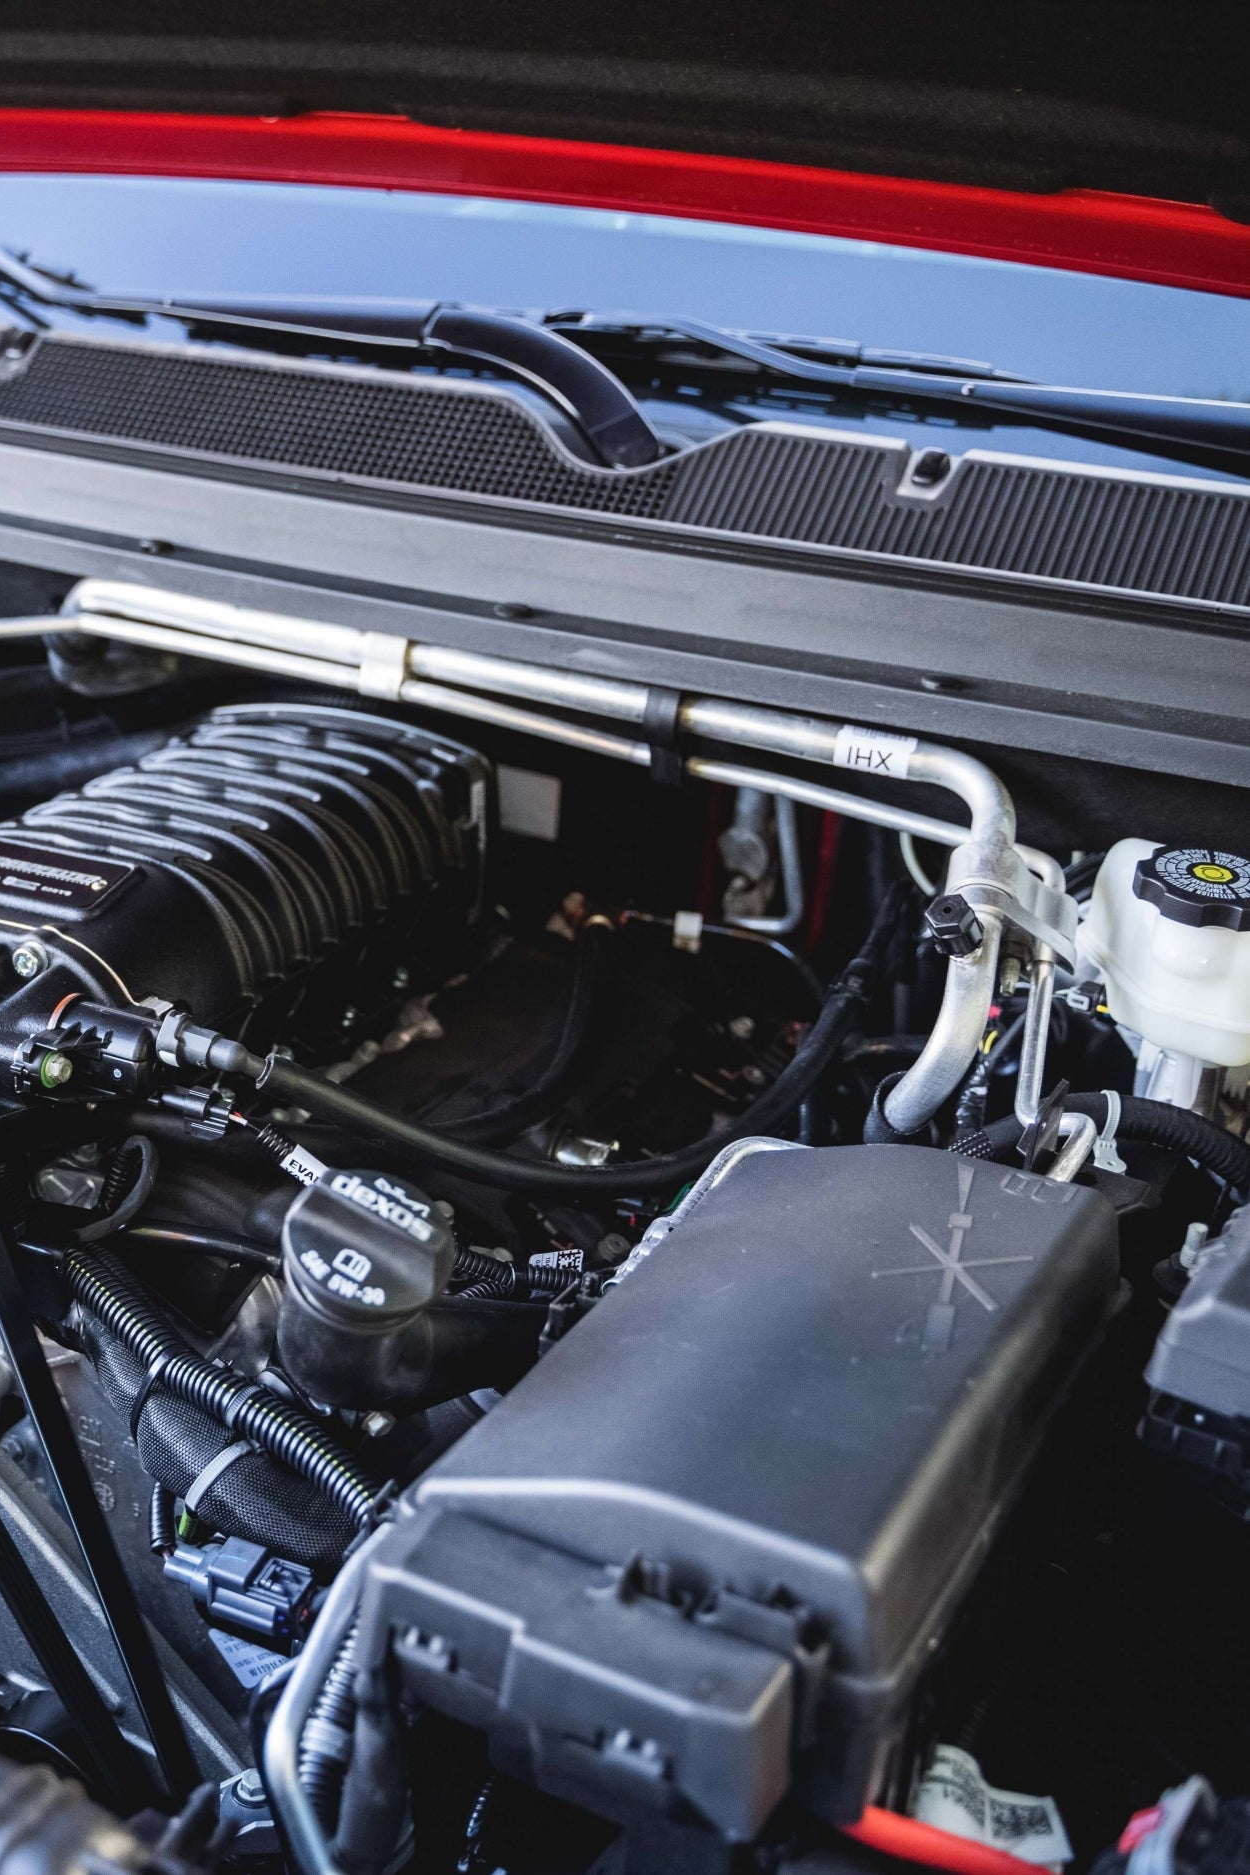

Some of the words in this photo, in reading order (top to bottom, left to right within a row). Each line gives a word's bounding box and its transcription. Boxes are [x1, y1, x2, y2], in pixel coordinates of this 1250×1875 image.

[846, 746, 892, 771] IHX
[288, 1158, 320, 1183] EVA
[330, 1174, 434, 1242] dexos
[300, 1249, 331, 1281] SAE
[327, 1273, 385, 1306] 5W-30
